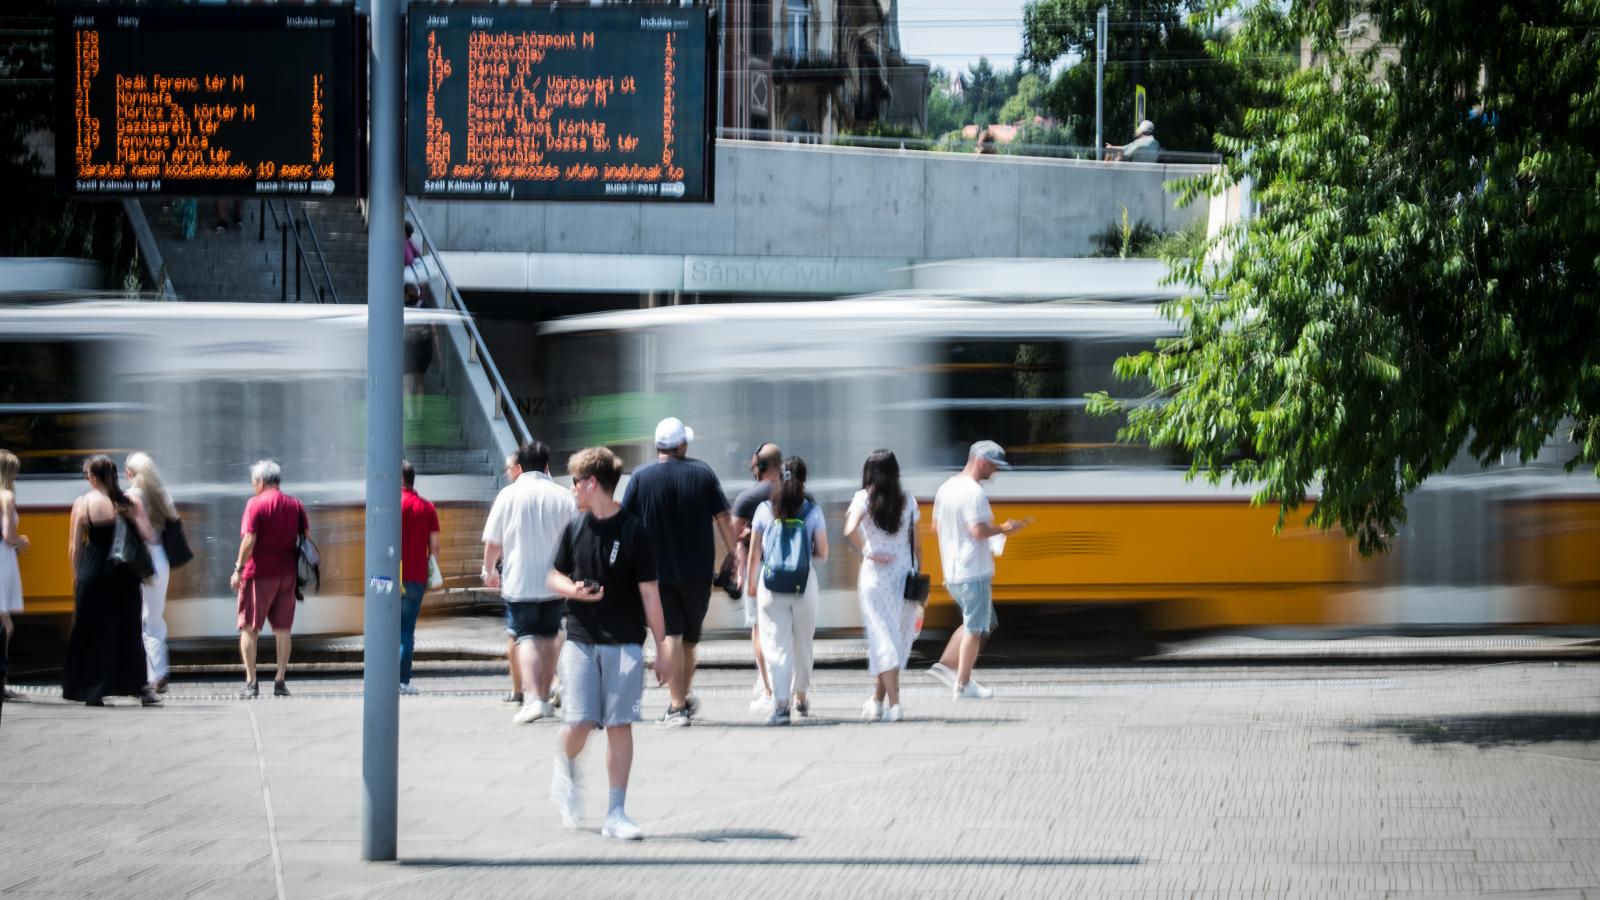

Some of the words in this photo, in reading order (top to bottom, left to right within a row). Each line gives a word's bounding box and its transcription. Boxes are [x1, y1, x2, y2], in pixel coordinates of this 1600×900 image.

[287, 15, 318, 27] Indulás
[427, 14, 448, 27] Járat
[471, 14, 493, 28] Irány
[640, 16, 672, 28] Indulás
[582, 31, 595, 49] M
[468, 60, 510, 78] Dániel
[516, 60, 532, 77] út
[116, 73, 147, 91] Deák
[153, 73, 198, 92] Ferenc
[205, 73, 226, 92] tér
[232, 73, 244, 91] M
[468, 75, 505, 92] Bécsi
[511, 74, 525, 92] út
[546, 74, 615, 94] Vörösvári
[621, 74, 636, 94] út
[116, 88, 171, 105] Normafa
[468, 90, 515, 107] Móricz
[545, 89, 590, 108] körtér
[595, 89, 607, 108] M
[116, 103, 164, 120] Móricz
[194, 103, 238, 121] körtér
[243, 103, 255, 121] M
[468, 104, 525, 121] Pasaréti
[532, 104, 554, 121] tér
[199, 117, 220, 136] tér
[467, 118, 506, 135] Szent
[513, 117, 553, 136] János
[558, 118, 606, 136] Kórház
[117, 132, 170, 150] Fenyves
[177, 131, 208, 150] utca
[546, 133, 587, 152] Dózsa
[617, 133, 640, 152] tér
[117, 147, 165, 164] Márton
[209, 146, 231, 164] tér
[131, 164, 160, 179] nem
[257, 162, 275, 179] 10
[431, 161, 447, 178] 10
[452, 164, 486, 179] perc
[491, 162, 560, 180] várakozás
[565, 163, 598, 181] után
[602, 162, 662, 181] indulnak
[76, 180, 97, 192] Széll
[100, 180, 134, 192] Kálmán
[136, 180, 148, 192] tér
[151, 181, 161, 192] M
[424, 180, 445, 193] Széll
[448, 180, 482, 193] Kálmán
[485, 181, 498, 193] tér
[500, 181, 509, 193] M
[691, 259, 773, 285] Sándy
